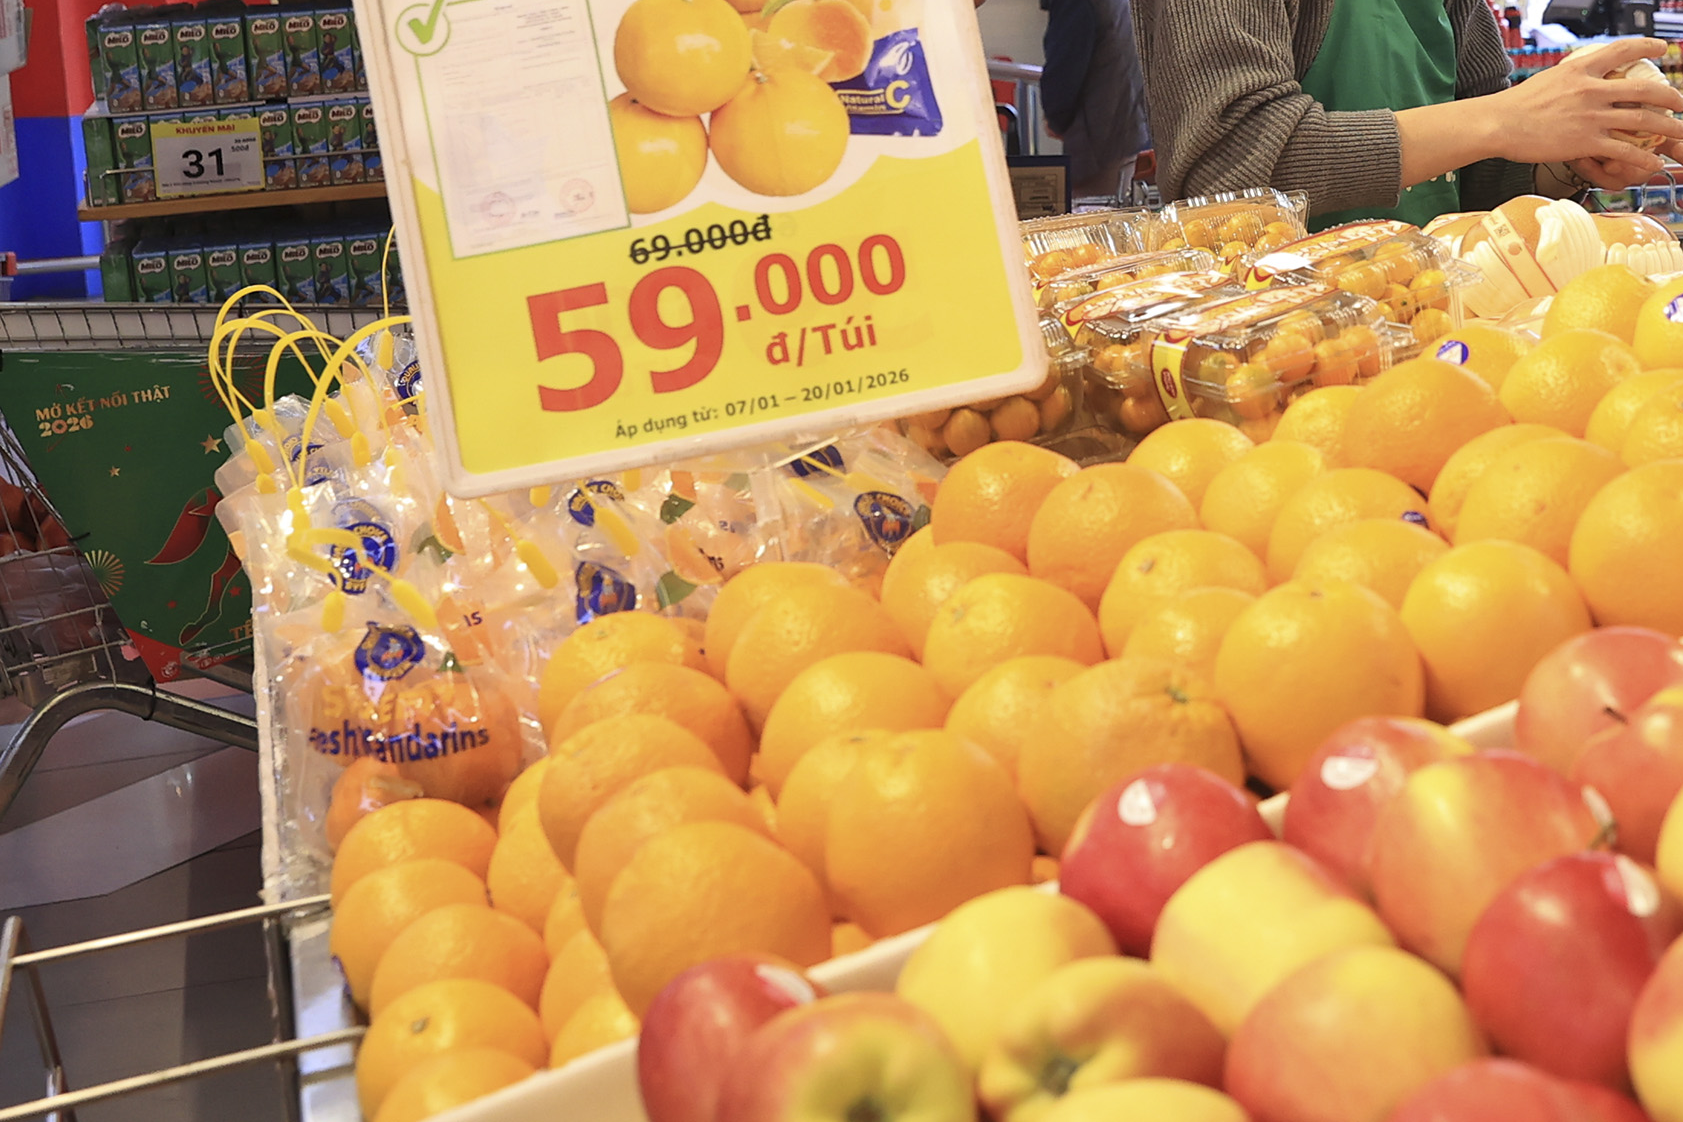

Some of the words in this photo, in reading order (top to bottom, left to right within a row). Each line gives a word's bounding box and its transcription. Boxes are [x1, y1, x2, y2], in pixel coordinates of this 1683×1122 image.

[254, 21, 275, 32] MILO
[288, 19, 310, 30] MILO
[323, 17, 344, 28] MILO
[144, 31, 166, 43] MILO
[180, 28, 202, 40] MILO
[215, 26, 236, 37] MILO
[108, 34, 129, 45] MILO
[886, 80, 911, 109] C
[263, 113, 284, 124] MILO
[297, 110, 318, 122] MILO
[331, 107, 353, 118] MILO
[120, 124, 143, 136] MILO
[182, 147, 225, 178] 31
[629, 214, 772, 264] 69.000đ
[319, 244, 340, 256] MILO
[353, 241, 374, 253] MILO
[212, 253, 233, 264] MILO
[246, 250, 268, 262] MILO
[284, 248, 305, 259] MILO
[141, 259, 163, 271] MILO
[177, 256, 199, 268] MILO
[766, 315, 877, 367] đ/Túi
[65, 396, 95, 416] KẾT
[101, 390, 128, 409] NỐI
[131, 384, 170, 403] THẬT
[615, 419, 638, 440] Áp
[643, 414, 688, 435] dụng
[692, 407, 719, 423] từ:
[725, 394, 780, 418] 07/01
[802, 368, 910, 403] 20/01/2026
[38, 414, 94, 438] 2026
